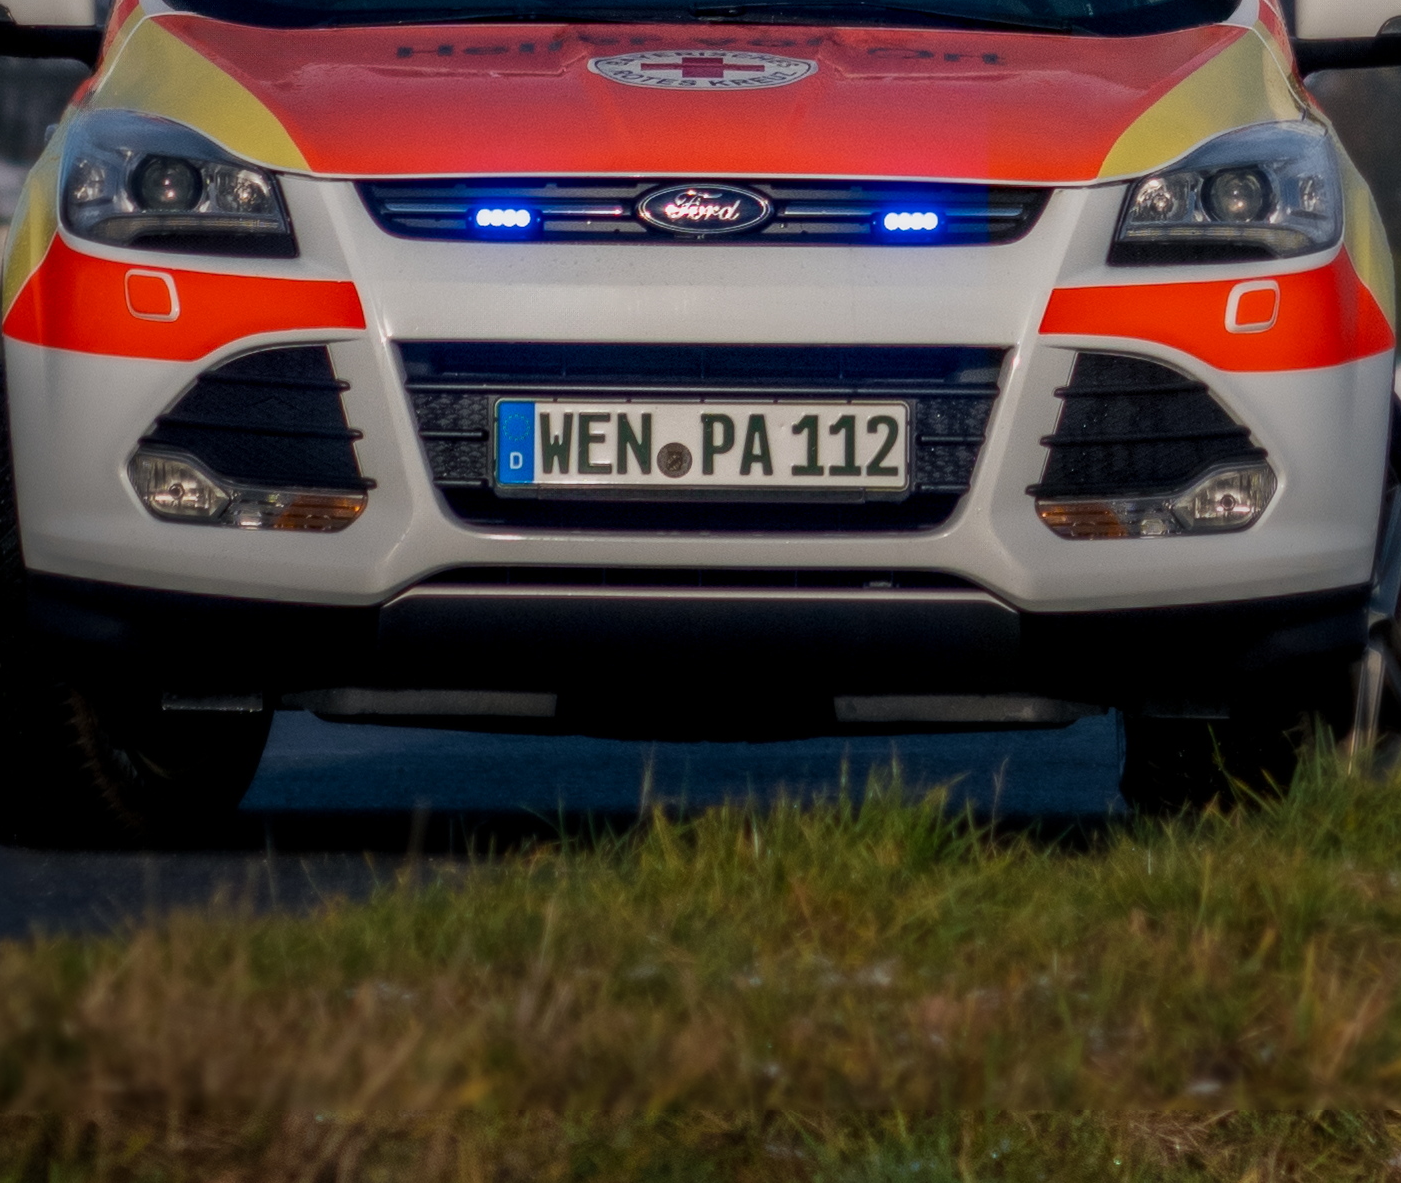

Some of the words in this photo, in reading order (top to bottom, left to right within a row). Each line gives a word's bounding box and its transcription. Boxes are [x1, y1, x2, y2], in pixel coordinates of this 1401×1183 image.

[612, 69, 698, 87] ROTES
[708, 70, 798, 87] KREUZ
[664, 189, 742, 221] Ford
[539, 412, 653, 475] WEN
[700, 413, 774, 476] PA
[790, 414, 899, 477] 112
[509, 452, 523, 469] D
